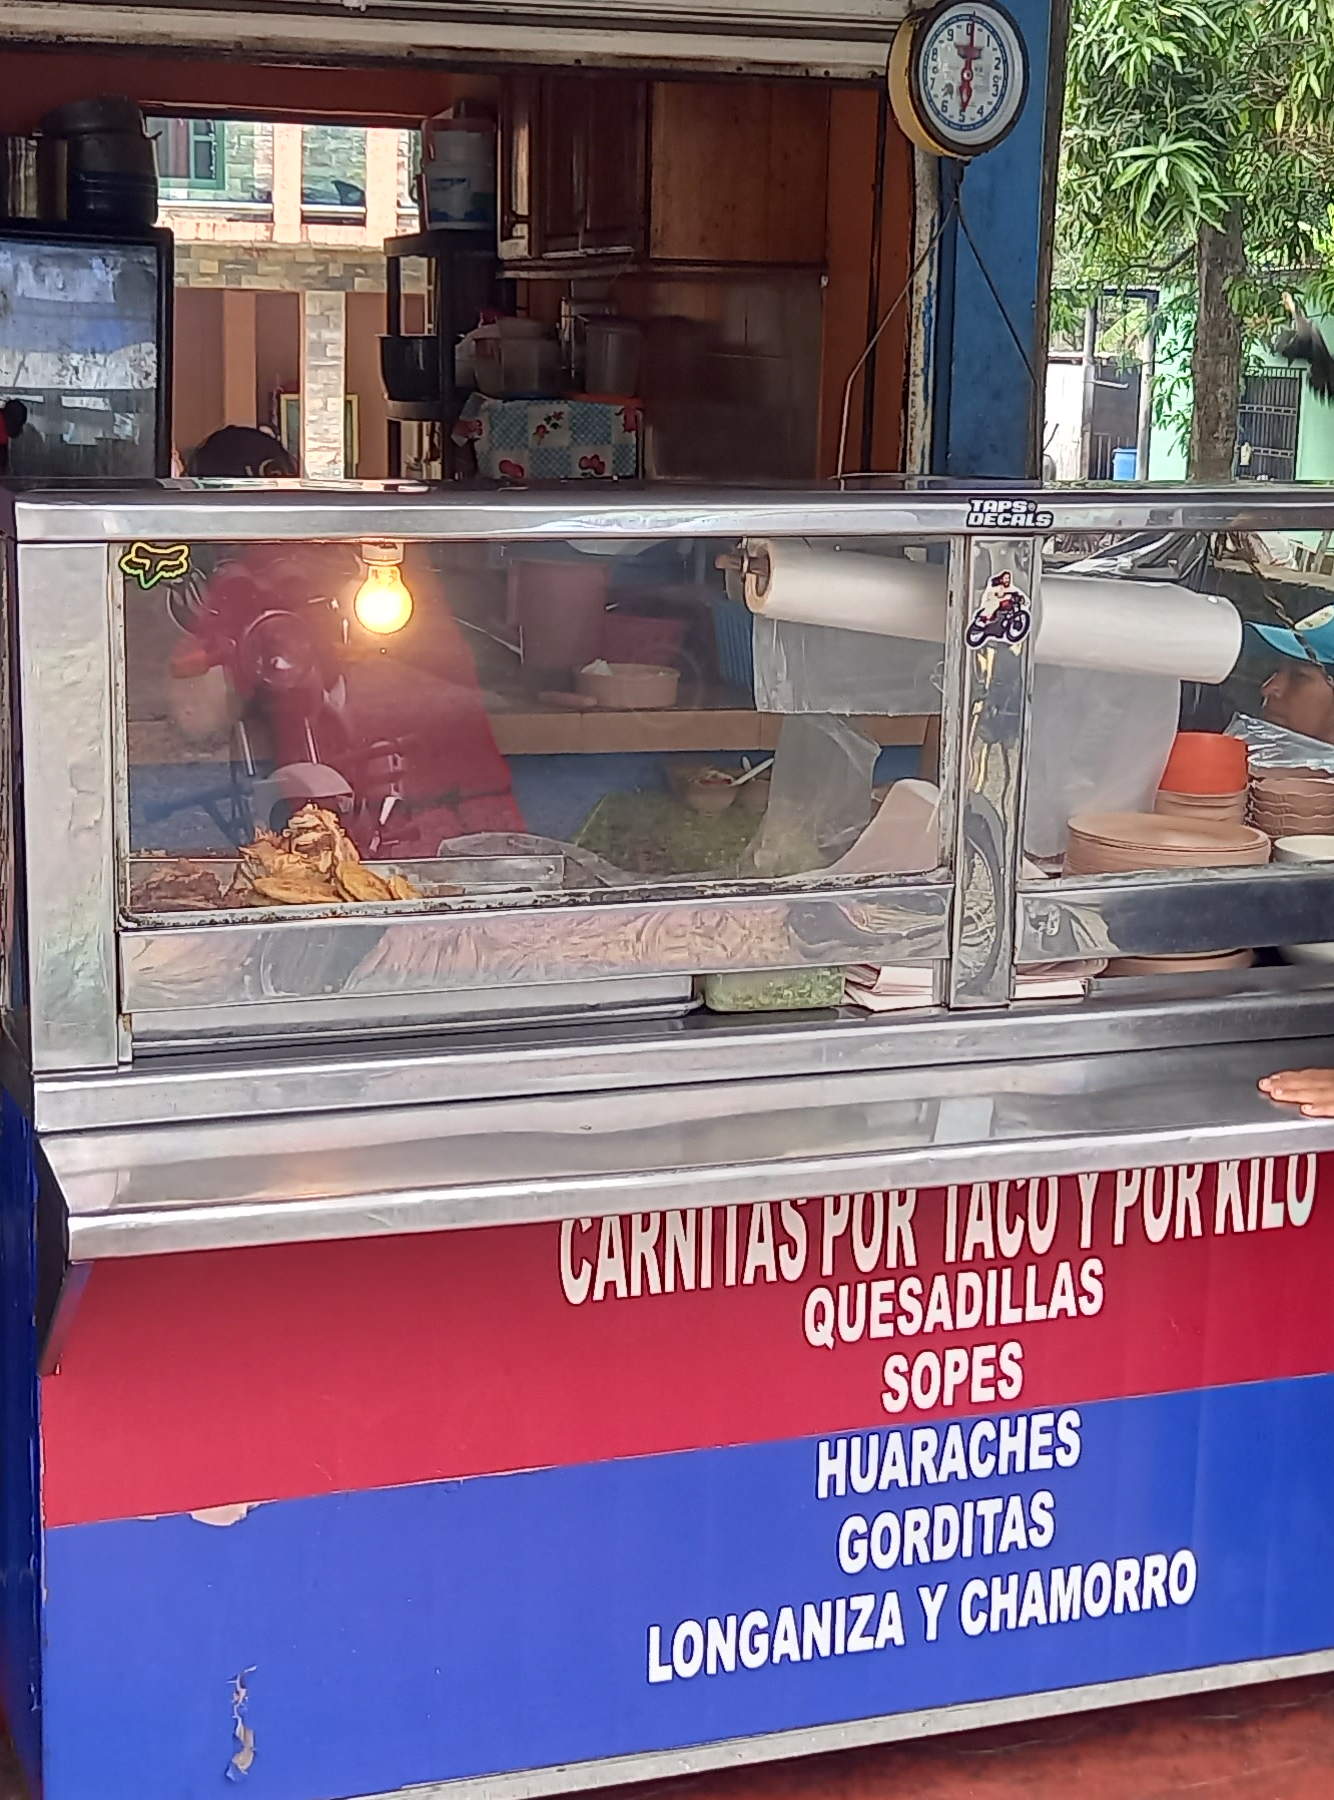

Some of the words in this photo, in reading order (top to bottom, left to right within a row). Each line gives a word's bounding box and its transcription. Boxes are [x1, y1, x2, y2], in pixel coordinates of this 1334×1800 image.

[947, 28, 954, 42] 9
[986, 34, 990, 48] 1
[931, 47, 938, 62] 8
[994, 56, 1001, 70] 2
[929, 77, 936, 91] 7
[991, 83, 999, 97] 3
[941, 99, 948, 113] 6
[976, 104, 984, 118] 4
[958, 108, 966, 123] 5
[970, 499, 1028, 513] TAPS
[967, 512, 1052, 527] DECALS
[559, 1198, 810, 1306] CARNITAS
[820, 1188, 918, 1278] POR
[943, 1176, 1059, 1264] TACO
[1077, 1172, 1100, 1250] Y
[1112, 1163, 1204, 1247] POR
[1213, 1153, 1317, 1236] KILO
[803, 1257, 1106, 1350] QUESADILLAS
[880, 1340, 1025, 1415] SOPES
[816, 1408, 1082, 1499] HUARACHES
[837, 1490, 1056, 1575] GORDITAS
[647, 1590, 906, 1684] LONGANIZA
[916, 1583, 949, 1643] Y
[959, 1548, 1197, 1637] CHAMORRO
